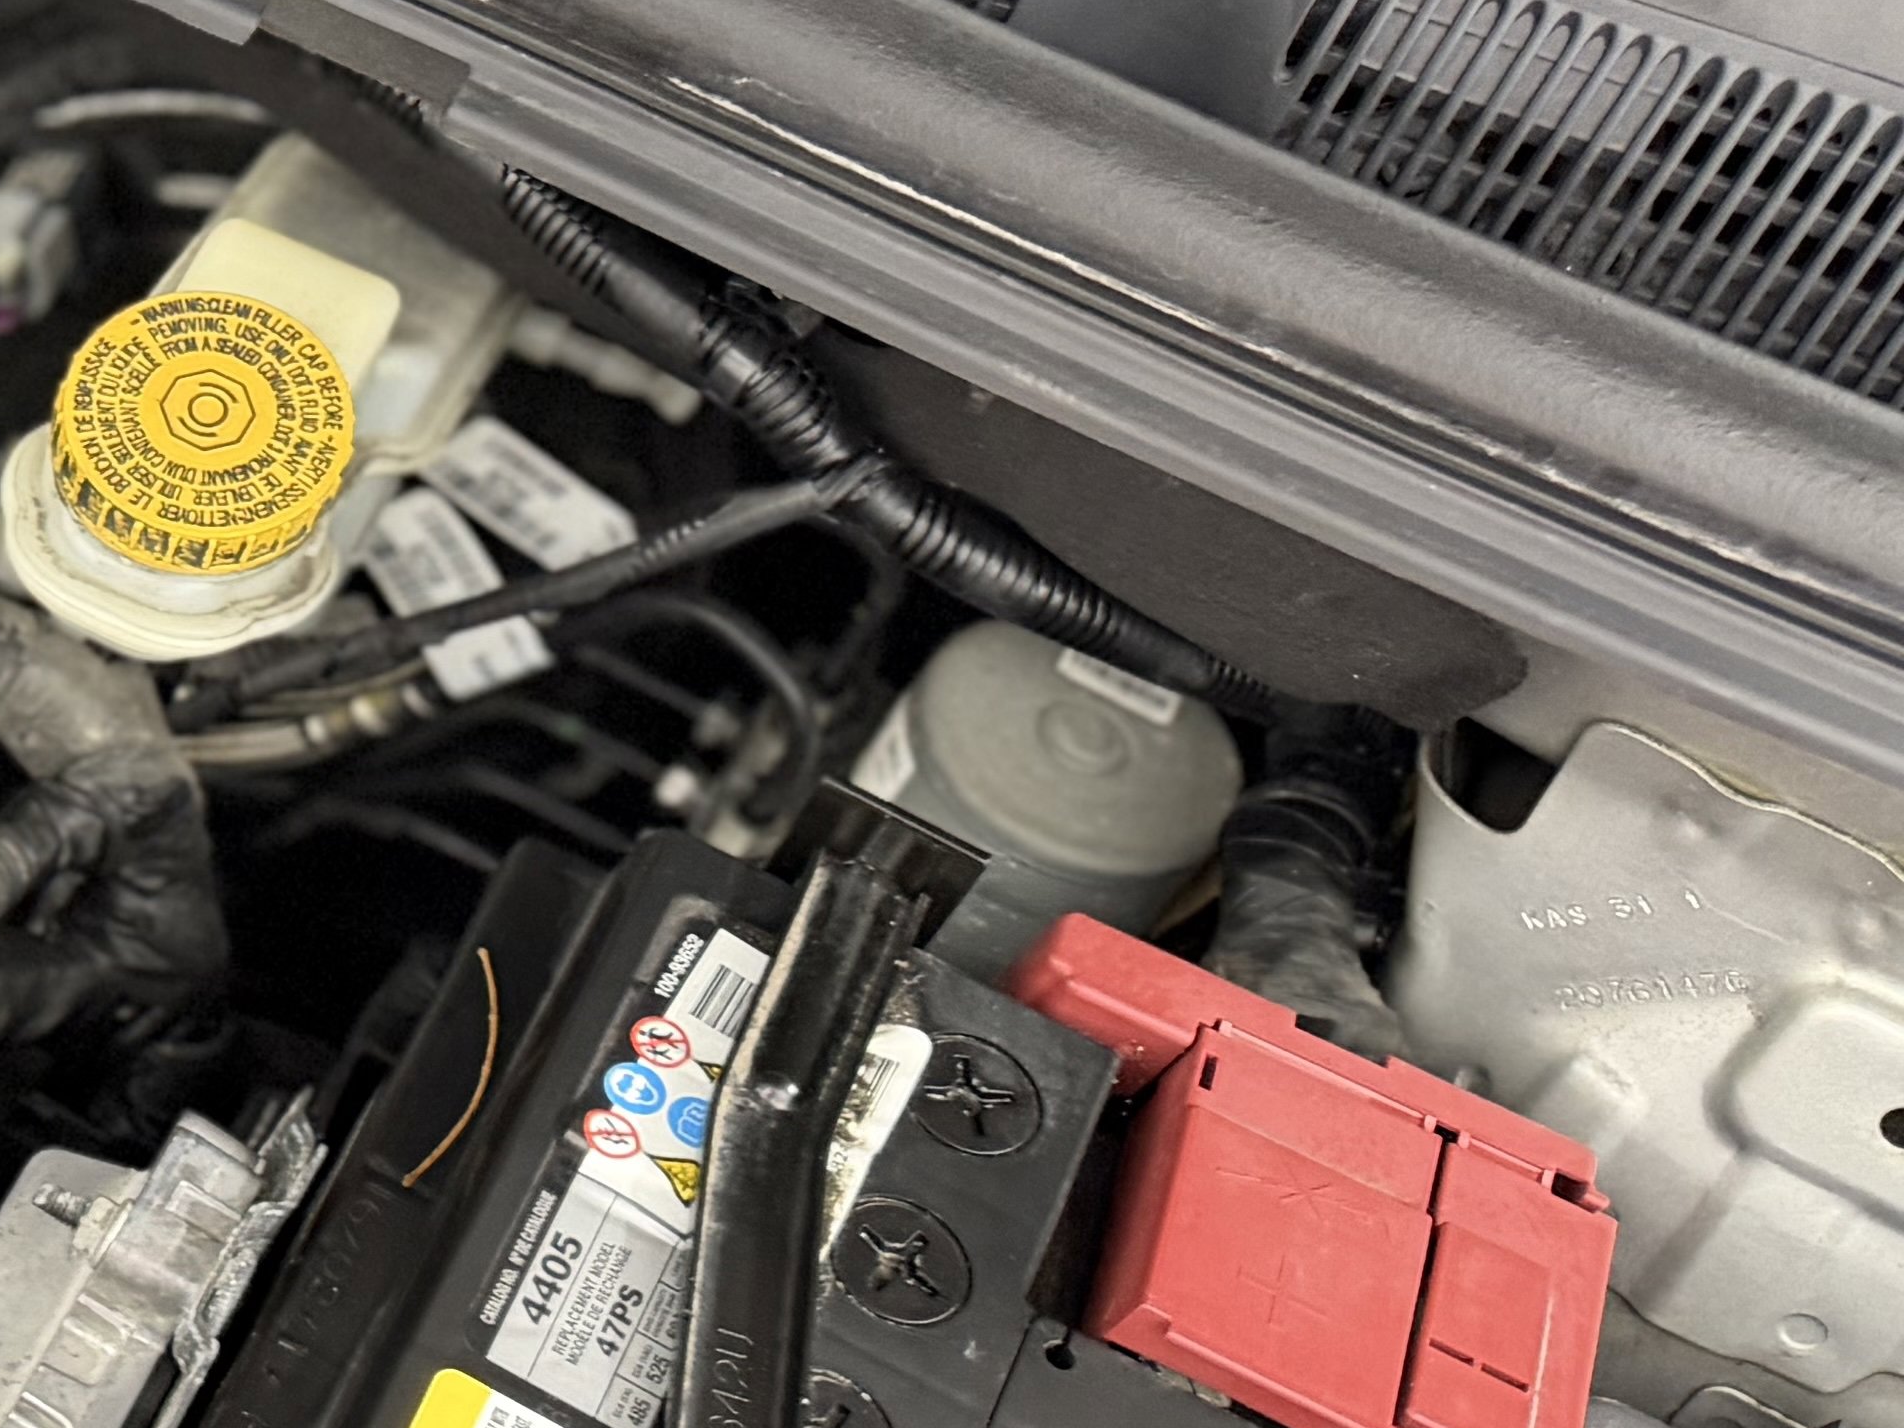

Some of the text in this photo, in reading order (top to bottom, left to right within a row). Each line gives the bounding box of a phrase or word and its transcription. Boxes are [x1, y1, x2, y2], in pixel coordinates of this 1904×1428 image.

[159, 337, 198, 360] FROM
[202, 336, 212, 352] A
[235, 322, 269, 347] USE
[253, 307, 303, 346] FILLER
[297, 343, 329, 371] CAP
[316, 375, 344, 430] BEFORE
[74, 414, 96, 433] DE
[128, 488, 154, 510] LE
[478, 1279, 513, 1327] CATALOG
[519, 1188, 557, 1244] CATALOGUE
[515, 1229, 584, 1328] 4405
[585, 1303, 603, 1321] DE
[594, 1244, 631, 1304] RECHANGE
[550, 1239, 616, 1356] REPLACEMENT MODEL
[591, 1282, 646, 1359] 47PS
[644, 1353, 671, 1385] 525
[625, 1395, 652, 1428] 485
